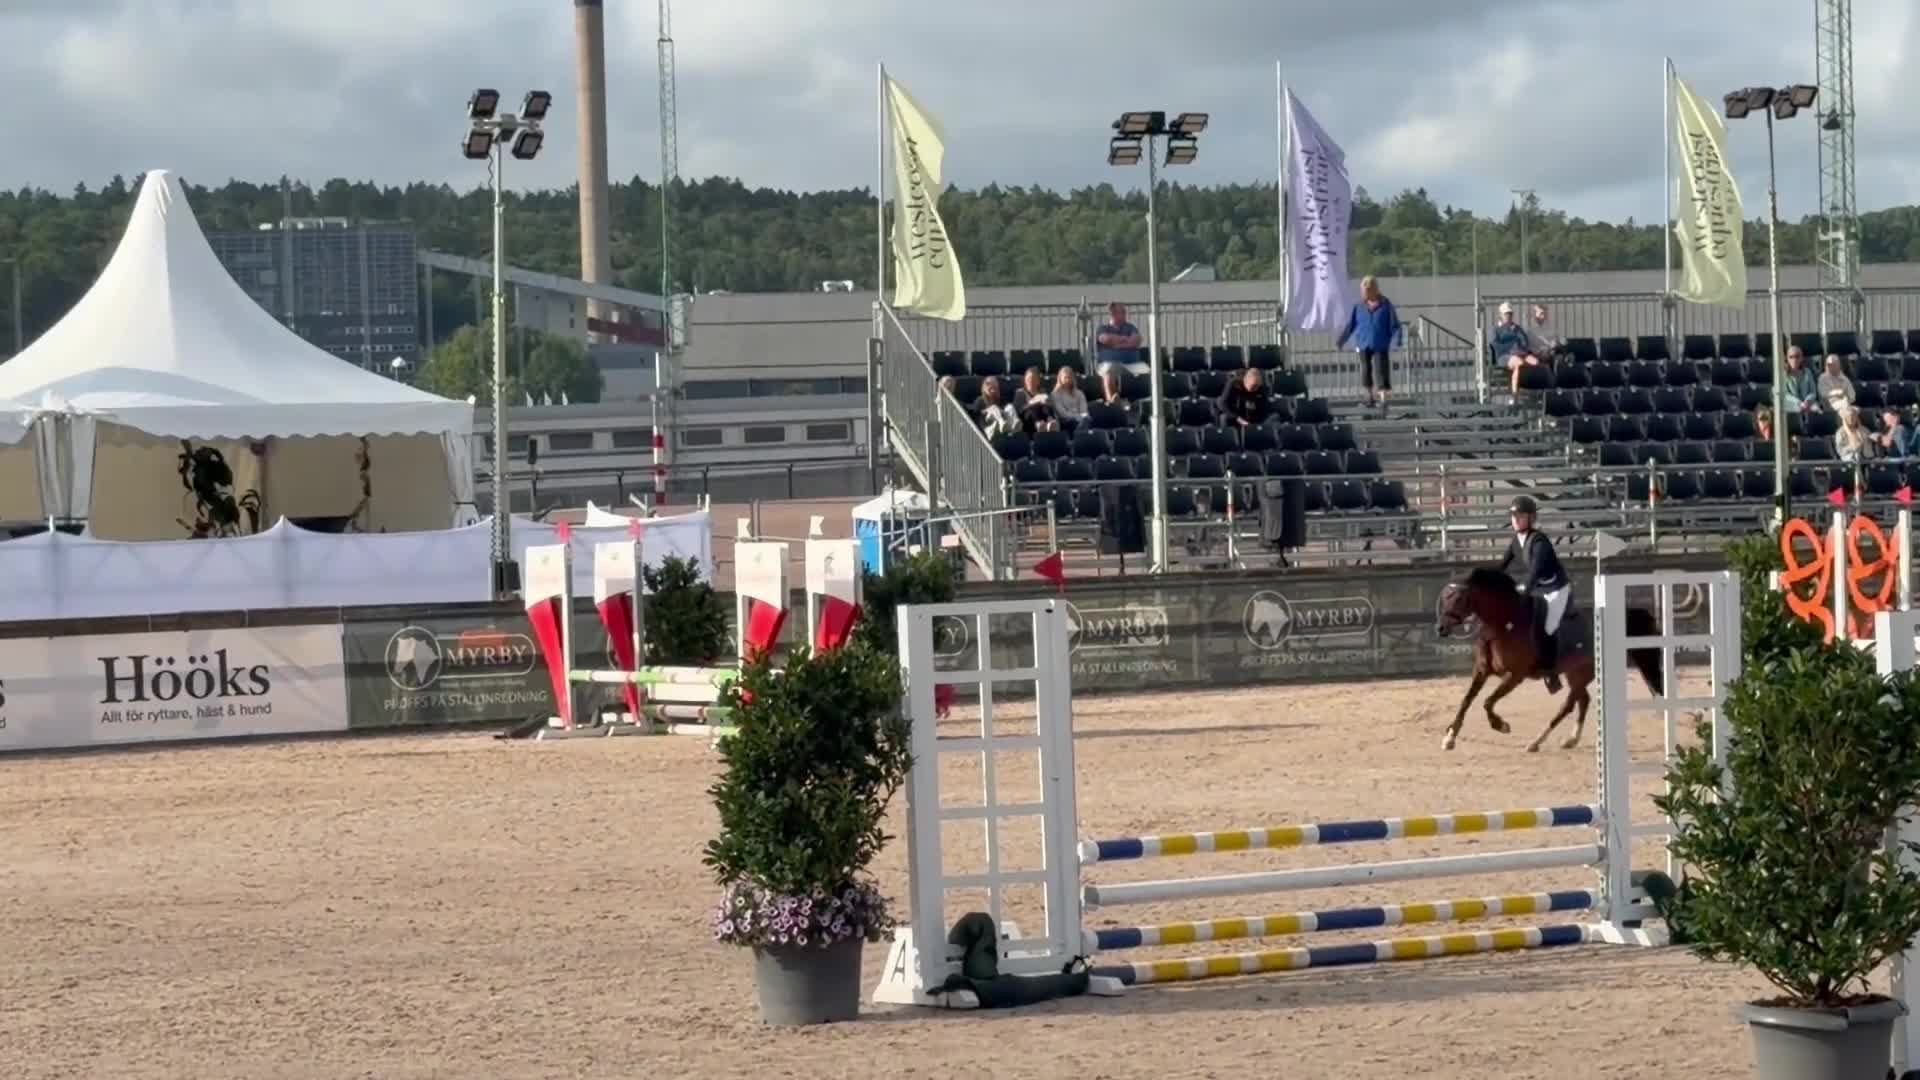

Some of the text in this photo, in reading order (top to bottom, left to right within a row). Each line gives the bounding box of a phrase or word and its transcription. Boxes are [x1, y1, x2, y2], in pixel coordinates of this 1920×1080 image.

[1087, 616, 1159, 638] MYRBY
[1296, 607, 1367, 627] MYRBY
[447, 645, 527, 666] MYRBY
[97, 648, 271, 704] Hööks
[101, 702, 272, 724] Allt för ryttare, häst & hund
